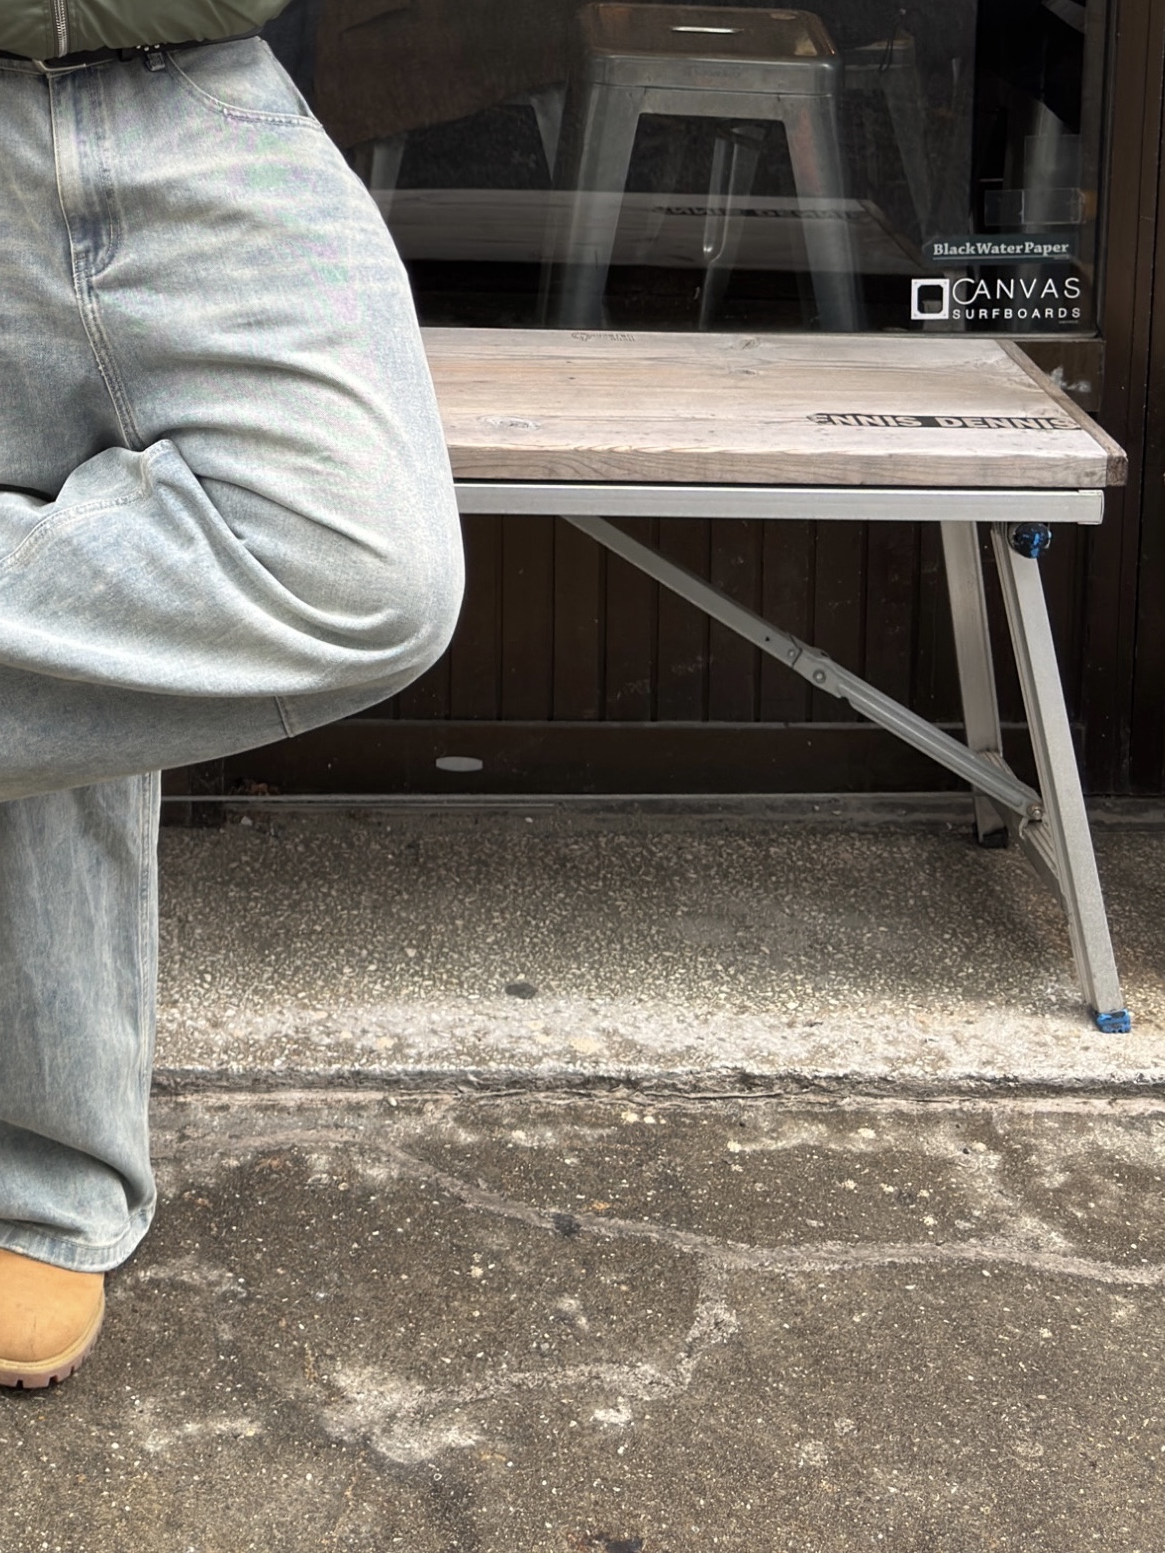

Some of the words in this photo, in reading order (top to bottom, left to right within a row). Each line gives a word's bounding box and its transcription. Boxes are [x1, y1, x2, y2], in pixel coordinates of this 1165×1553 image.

[952, 277, 1081, 305] CANVAS
[952, 308, 1081, 319] SURFBOARDS
[935, 417, 1079, 429] DENNIS
